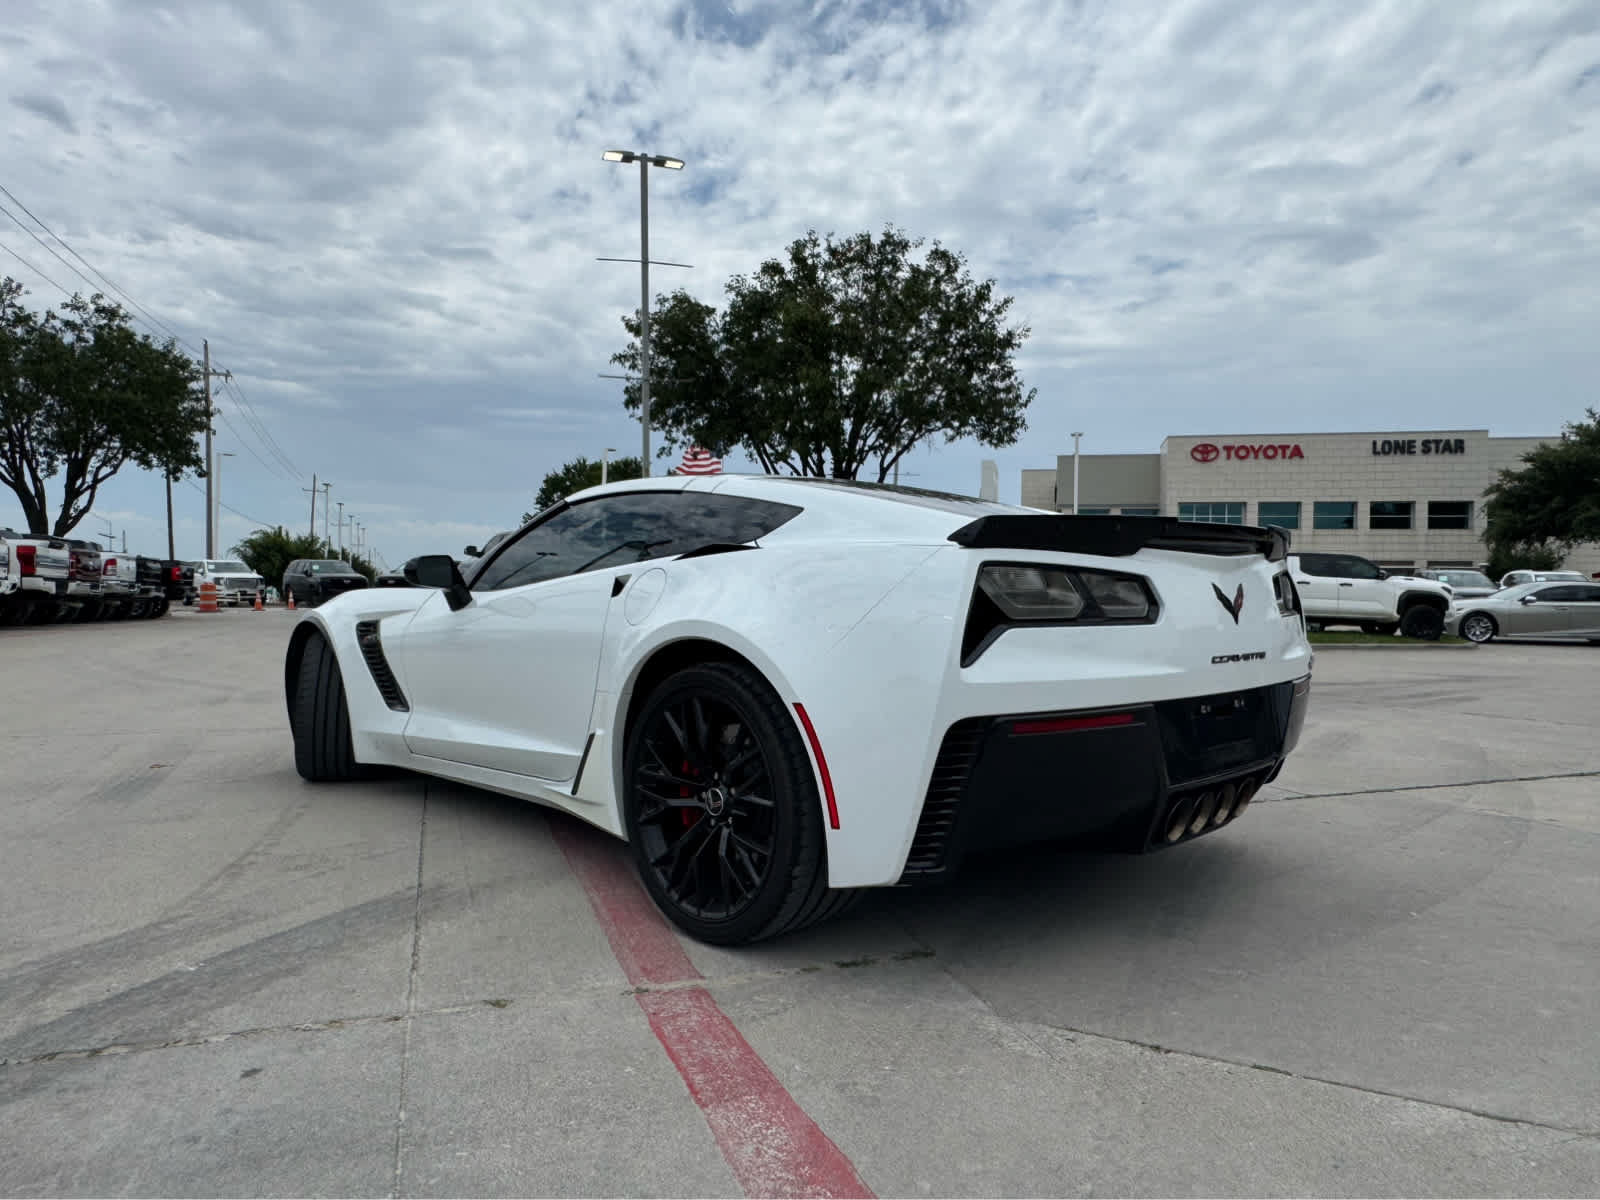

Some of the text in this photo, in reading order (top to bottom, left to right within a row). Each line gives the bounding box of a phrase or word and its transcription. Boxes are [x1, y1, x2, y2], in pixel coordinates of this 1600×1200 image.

[1222, 444, 1304, 460] TOYOTA
[1371, 438, 1465, 456] LONE STAR
